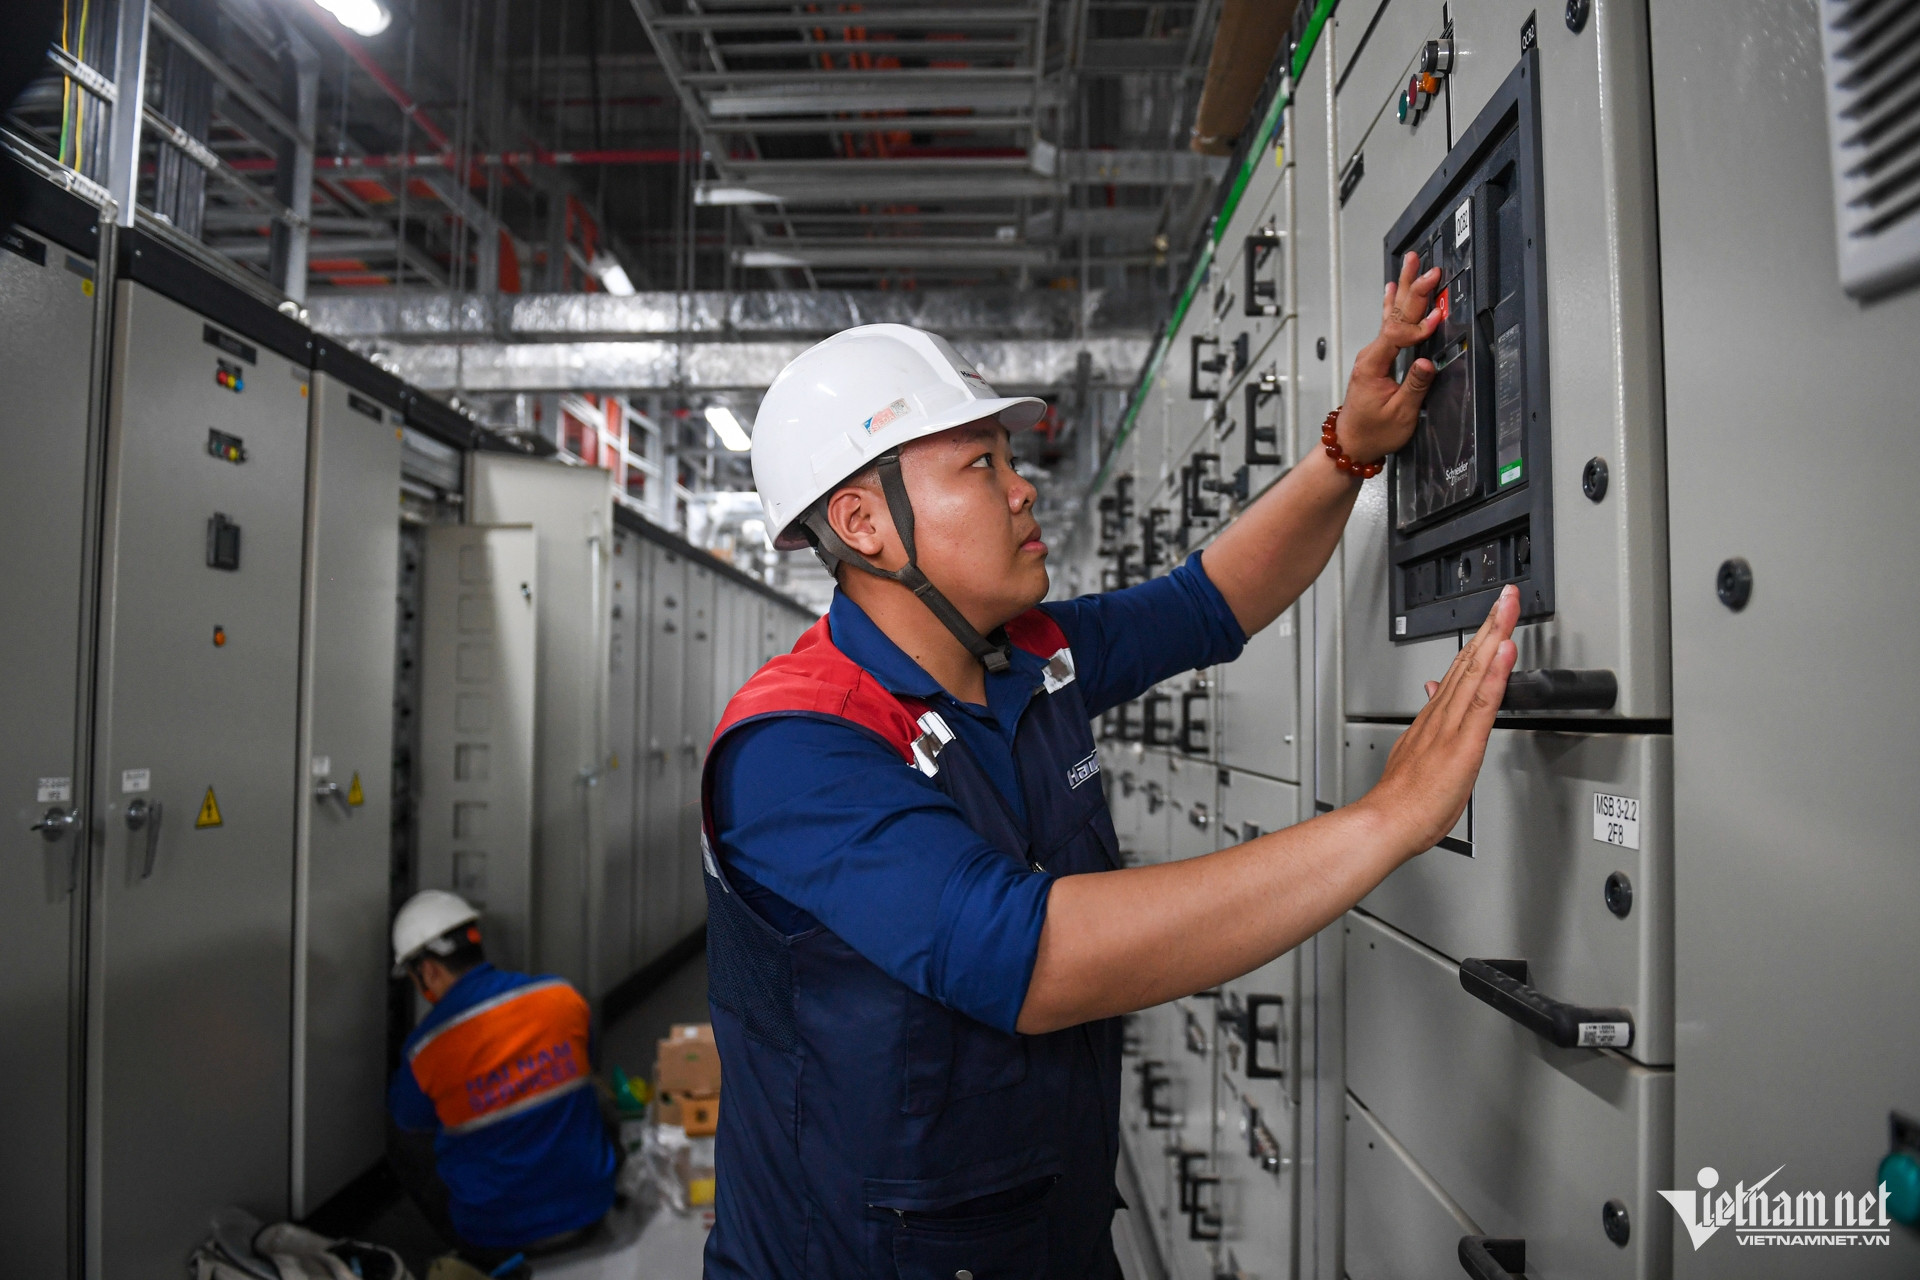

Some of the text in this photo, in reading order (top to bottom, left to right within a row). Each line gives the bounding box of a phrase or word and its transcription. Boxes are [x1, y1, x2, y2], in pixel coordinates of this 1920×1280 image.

[1522, 24, 1535, 50] QCB2
[1456, 209, 1468, 237] QCB2
[1445, 461, 1468, 481] Schneider
[1596, 794, 1637, 822] MSB 3-2.2
[1608, 822, 1624, 845] 2F8
[516, 1041, 572, 1074] NAM
